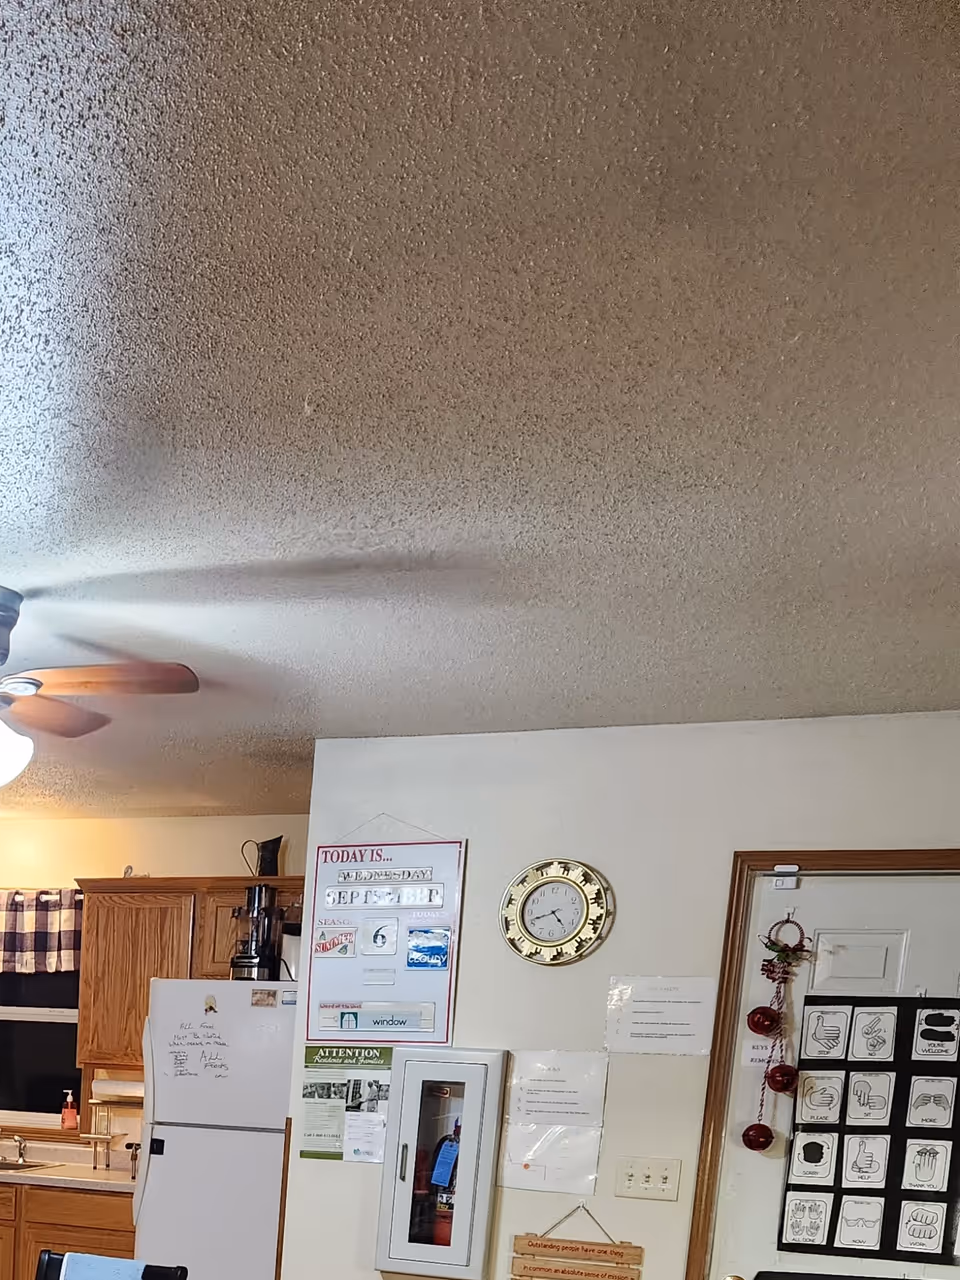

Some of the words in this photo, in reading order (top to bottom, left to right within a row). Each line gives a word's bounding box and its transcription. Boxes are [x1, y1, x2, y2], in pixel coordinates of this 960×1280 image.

[321, 849, 368, 864] TODAY
[370, 848, 393, 862] IS...
[341, 869, 429, 881] WEDNESDAY
[571, 896, 577, 905] 2
[317, 918, 352, 926] SEASO
[372, 924, 388, 948] 6
[314, 932, 354, 953] SUMMER
[407, 954, 448, 966] CLOUDY
[372, 1015, 407, 1026] window
[317, 1048, 381, 1058] ATTENTION
[528, 1240, 561, 1251] Outstanding
[610, 1249, 624, 1258] thing
[561, 1268, 583, 1276] absolute
